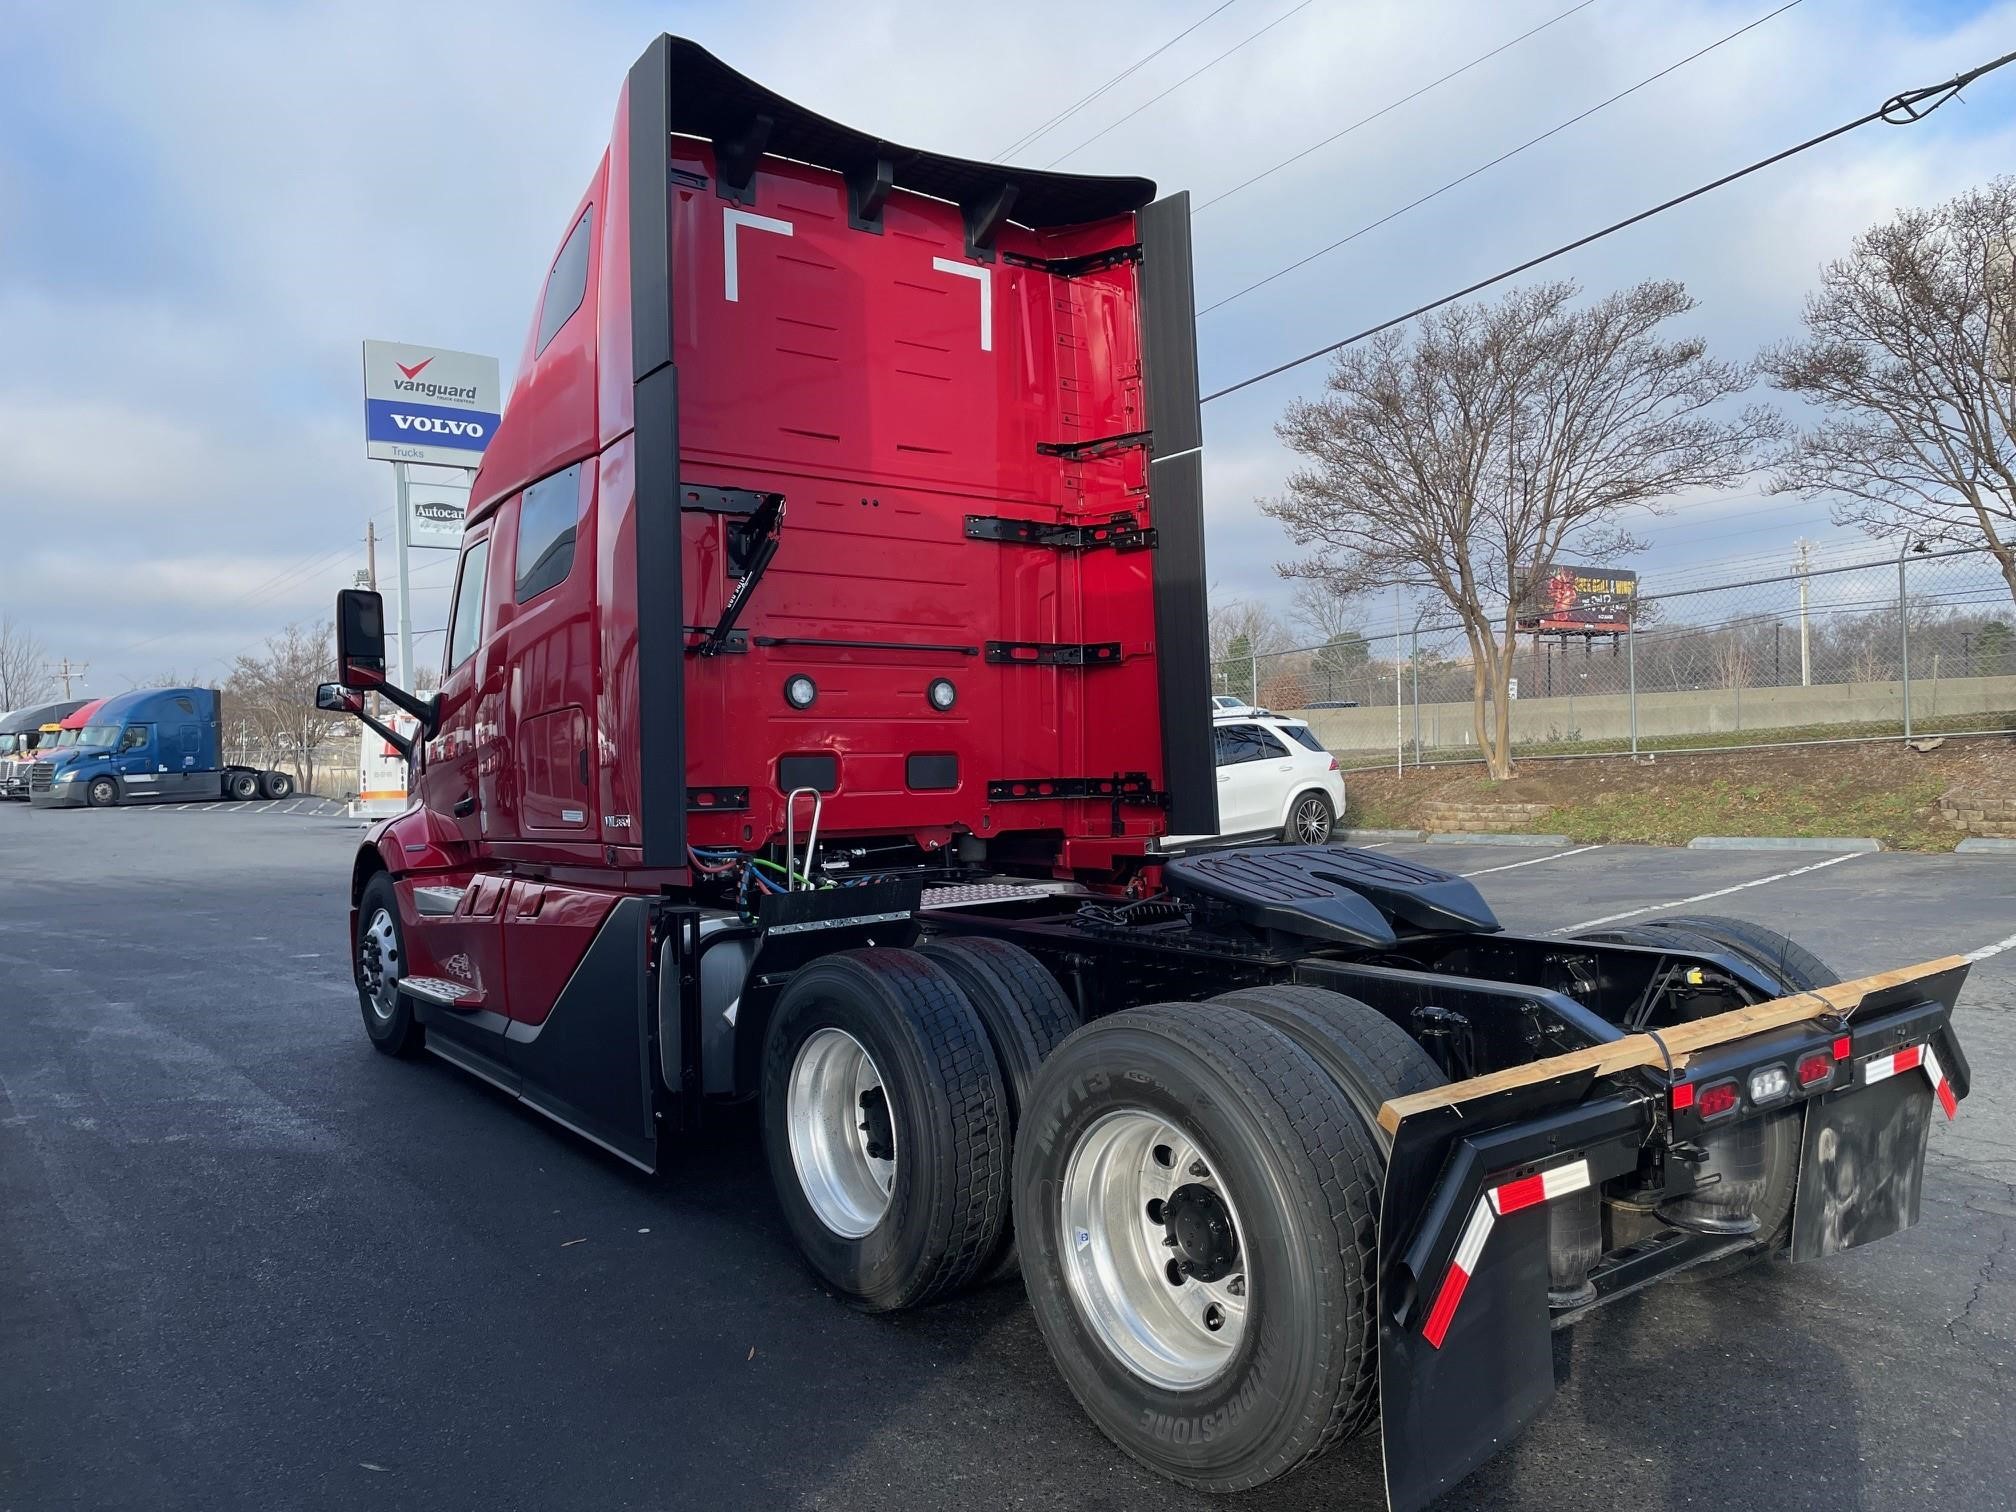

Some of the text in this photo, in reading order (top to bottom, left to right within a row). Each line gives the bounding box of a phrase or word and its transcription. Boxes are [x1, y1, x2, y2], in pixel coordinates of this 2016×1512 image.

[394, 379, 477, 400] vanguard
[390, 414, 484, 438] VOLVO
[391, 446, 425, 459] Trucks
[416, 504, 465, 520] Autocar
